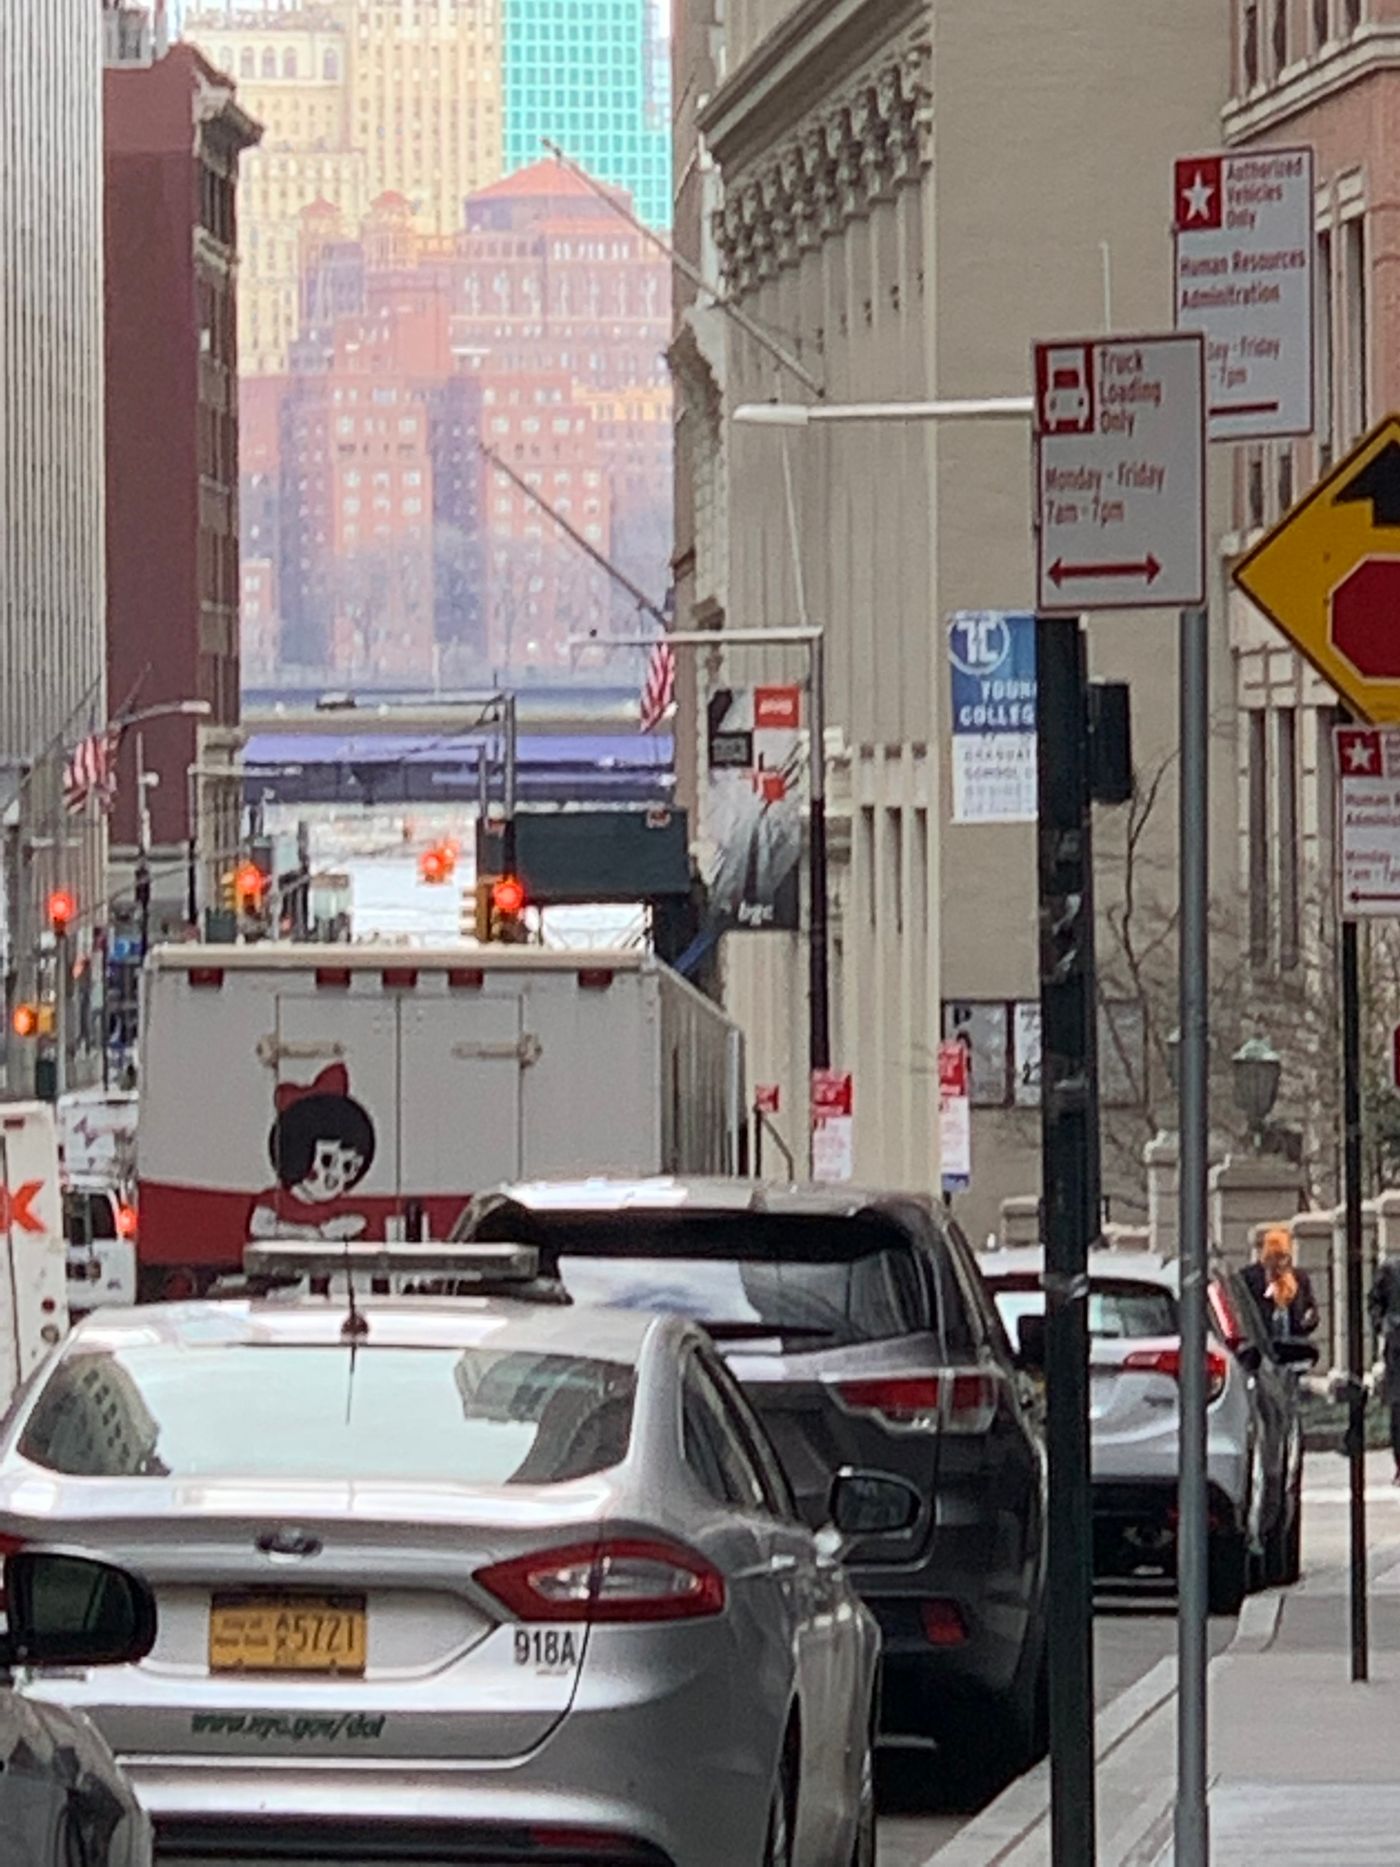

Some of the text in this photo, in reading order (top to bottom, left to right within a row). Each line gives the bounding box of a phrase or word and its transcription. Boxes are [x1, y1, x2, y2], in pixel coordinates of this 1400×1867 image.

[1101, 348, 1143, 374] Truck
[1101, 377, 1162, 407] Loading
[1101, 409, 1136, 437] Only
[1045, 466, 1102, 493] Monday
[1117, 461, 1166, 493] Friday
[960, 704, 1035, 727] COLLEG
[514, 1629, 577, 1668] 918A
